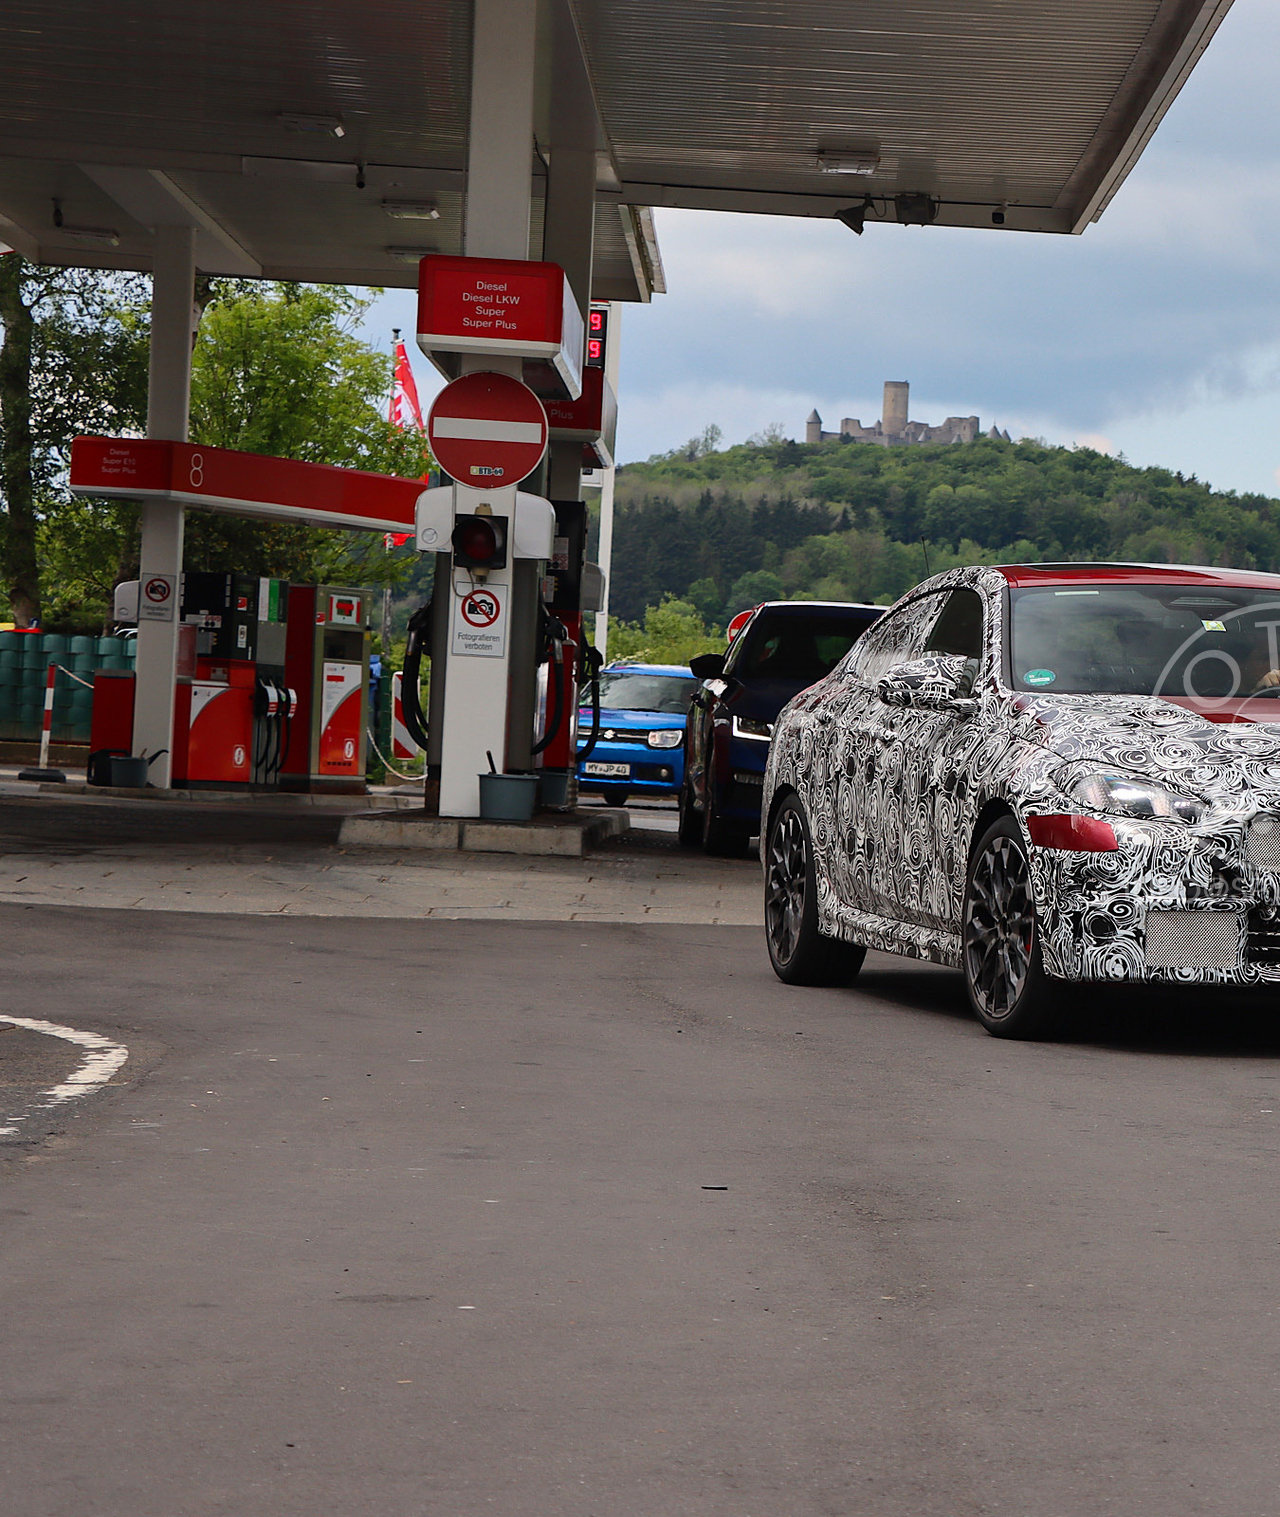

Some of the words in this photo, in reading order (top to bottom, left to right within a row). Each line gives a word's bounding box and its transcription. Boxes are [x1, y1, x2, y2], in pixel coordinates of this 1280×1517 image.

[476, 280, 508, 292] Diesel
[462, 292, 494, 304] Diesel
[496, 294, 520, 305] LKW
[475, 306, 506, 317] Super
[462, 317, 492, 329] Super
[495, 319, 517, 330] Plus
[551, 409, 574, 419] Plus
[109, 448, 130, 456] Diesel
[102, 457, 122, 465] Super
[101, 466, 121, 474] Super
[189, 453, 204, 487] 8
[457, 631, 501, 642] Fotografieren
[464, 642, 493, 651] verboten
